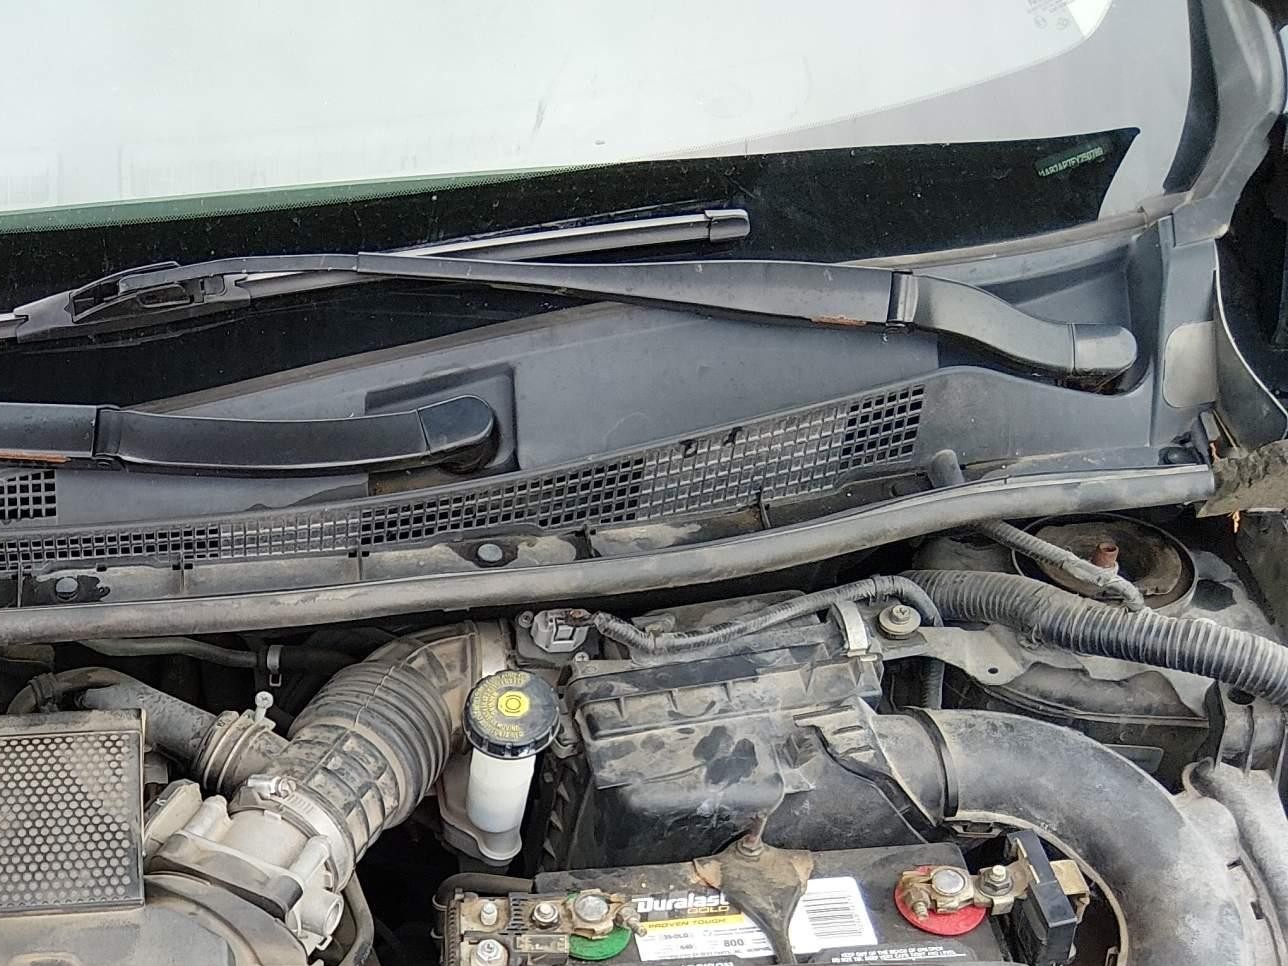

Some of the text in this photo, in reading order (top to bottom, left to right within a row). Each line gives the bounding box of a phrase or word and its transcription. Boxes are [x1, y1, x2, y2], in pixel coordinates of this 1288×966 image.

[631, 892, 730, 913] Duralast
[687, 905, 730, 914] GOLD
[648, 918, 726, 929] PROVEN TOUGH
[723, 938, 745, 948] 800
